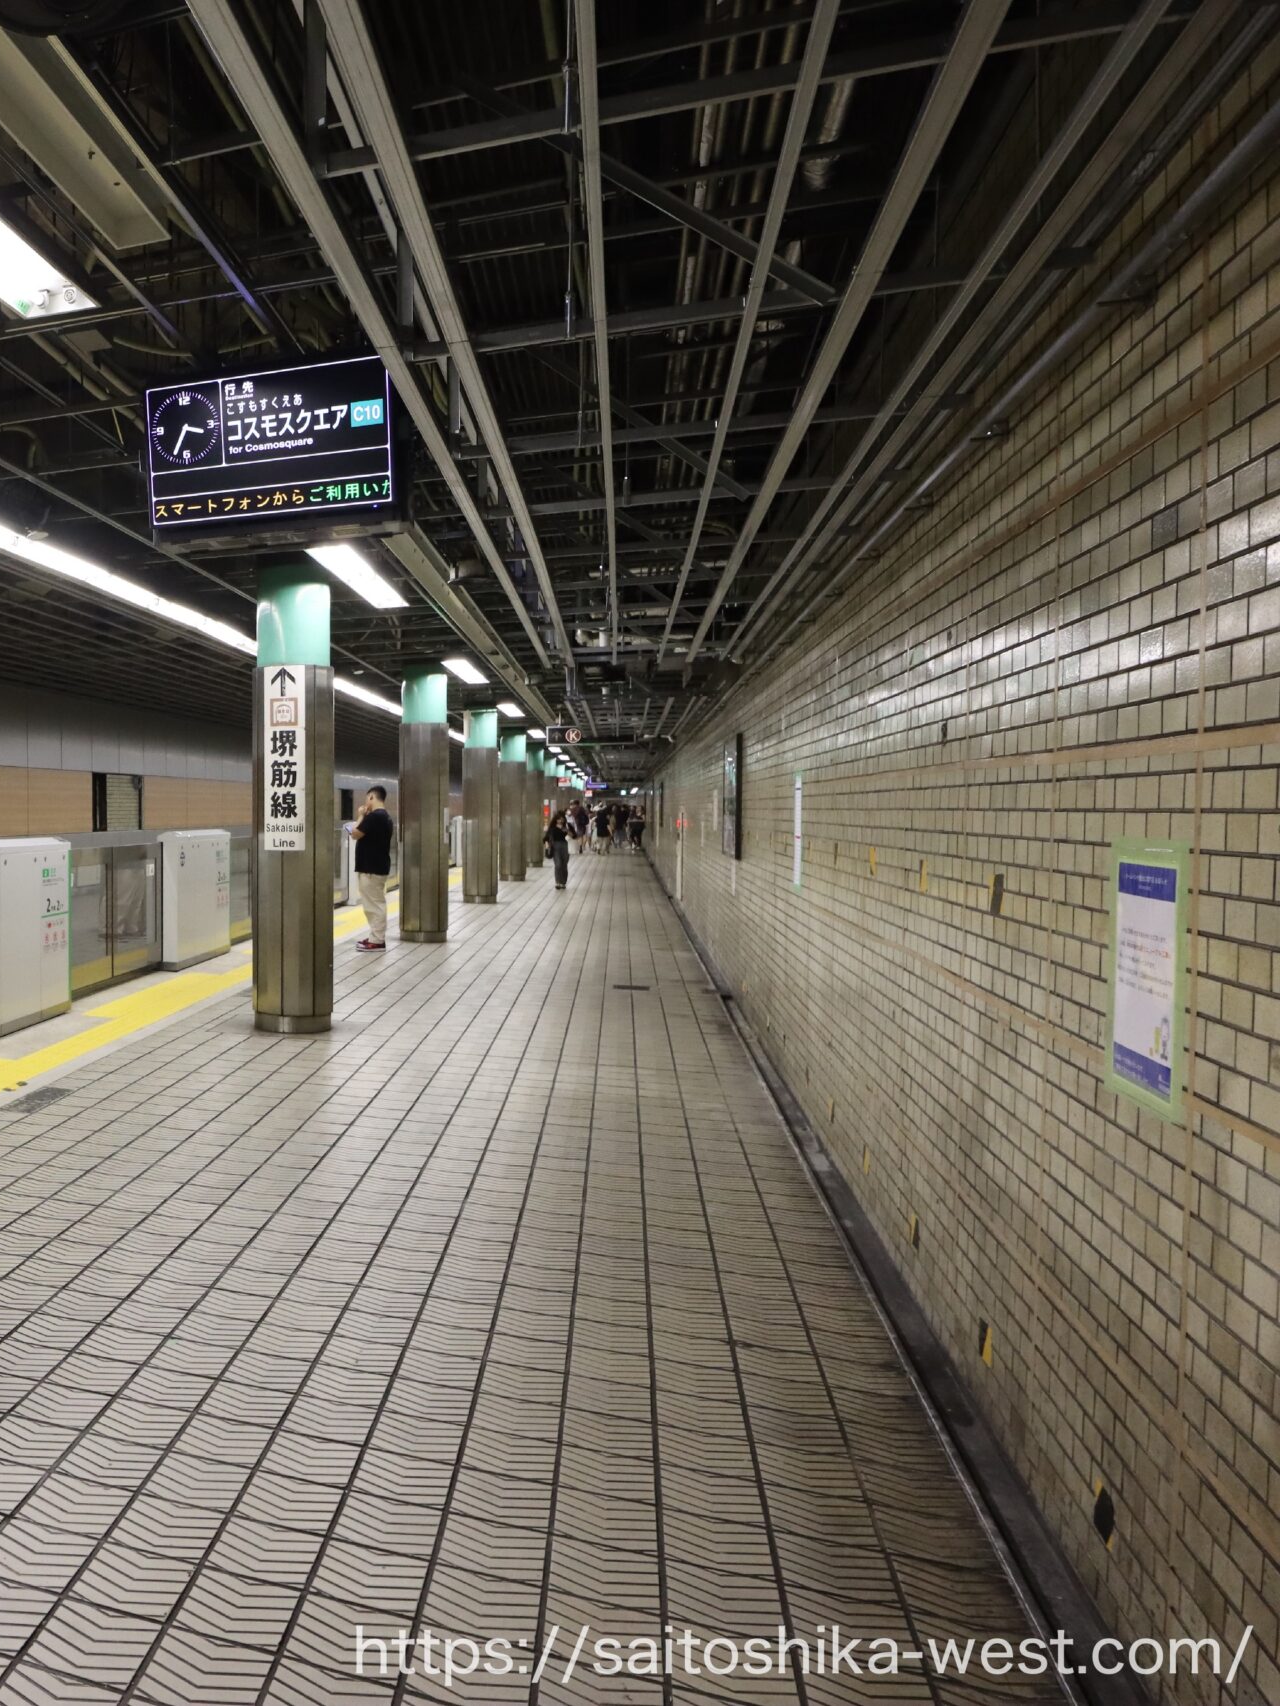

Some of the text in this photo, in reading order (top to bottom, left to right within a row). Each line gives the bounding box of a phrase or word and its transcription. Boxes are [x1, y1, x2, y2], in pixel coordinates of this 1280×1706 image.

[178, 396, 191, 406] 12
[226, 394, 303, 415] こすもすくえあ
[206, 420, 214, 429] 3
[227, 405, 381, 441] コスモスクエア C10
[156, 426, 165, 436] 9
[229, 437, 313, 454] for Cosmosquare
[182, 450, 191, 459] 6
[270, 730, 298, 819] 堺筋線
[266, 823, 304, 834] Sakaisuji
[272, 838, 296, 848] Line
